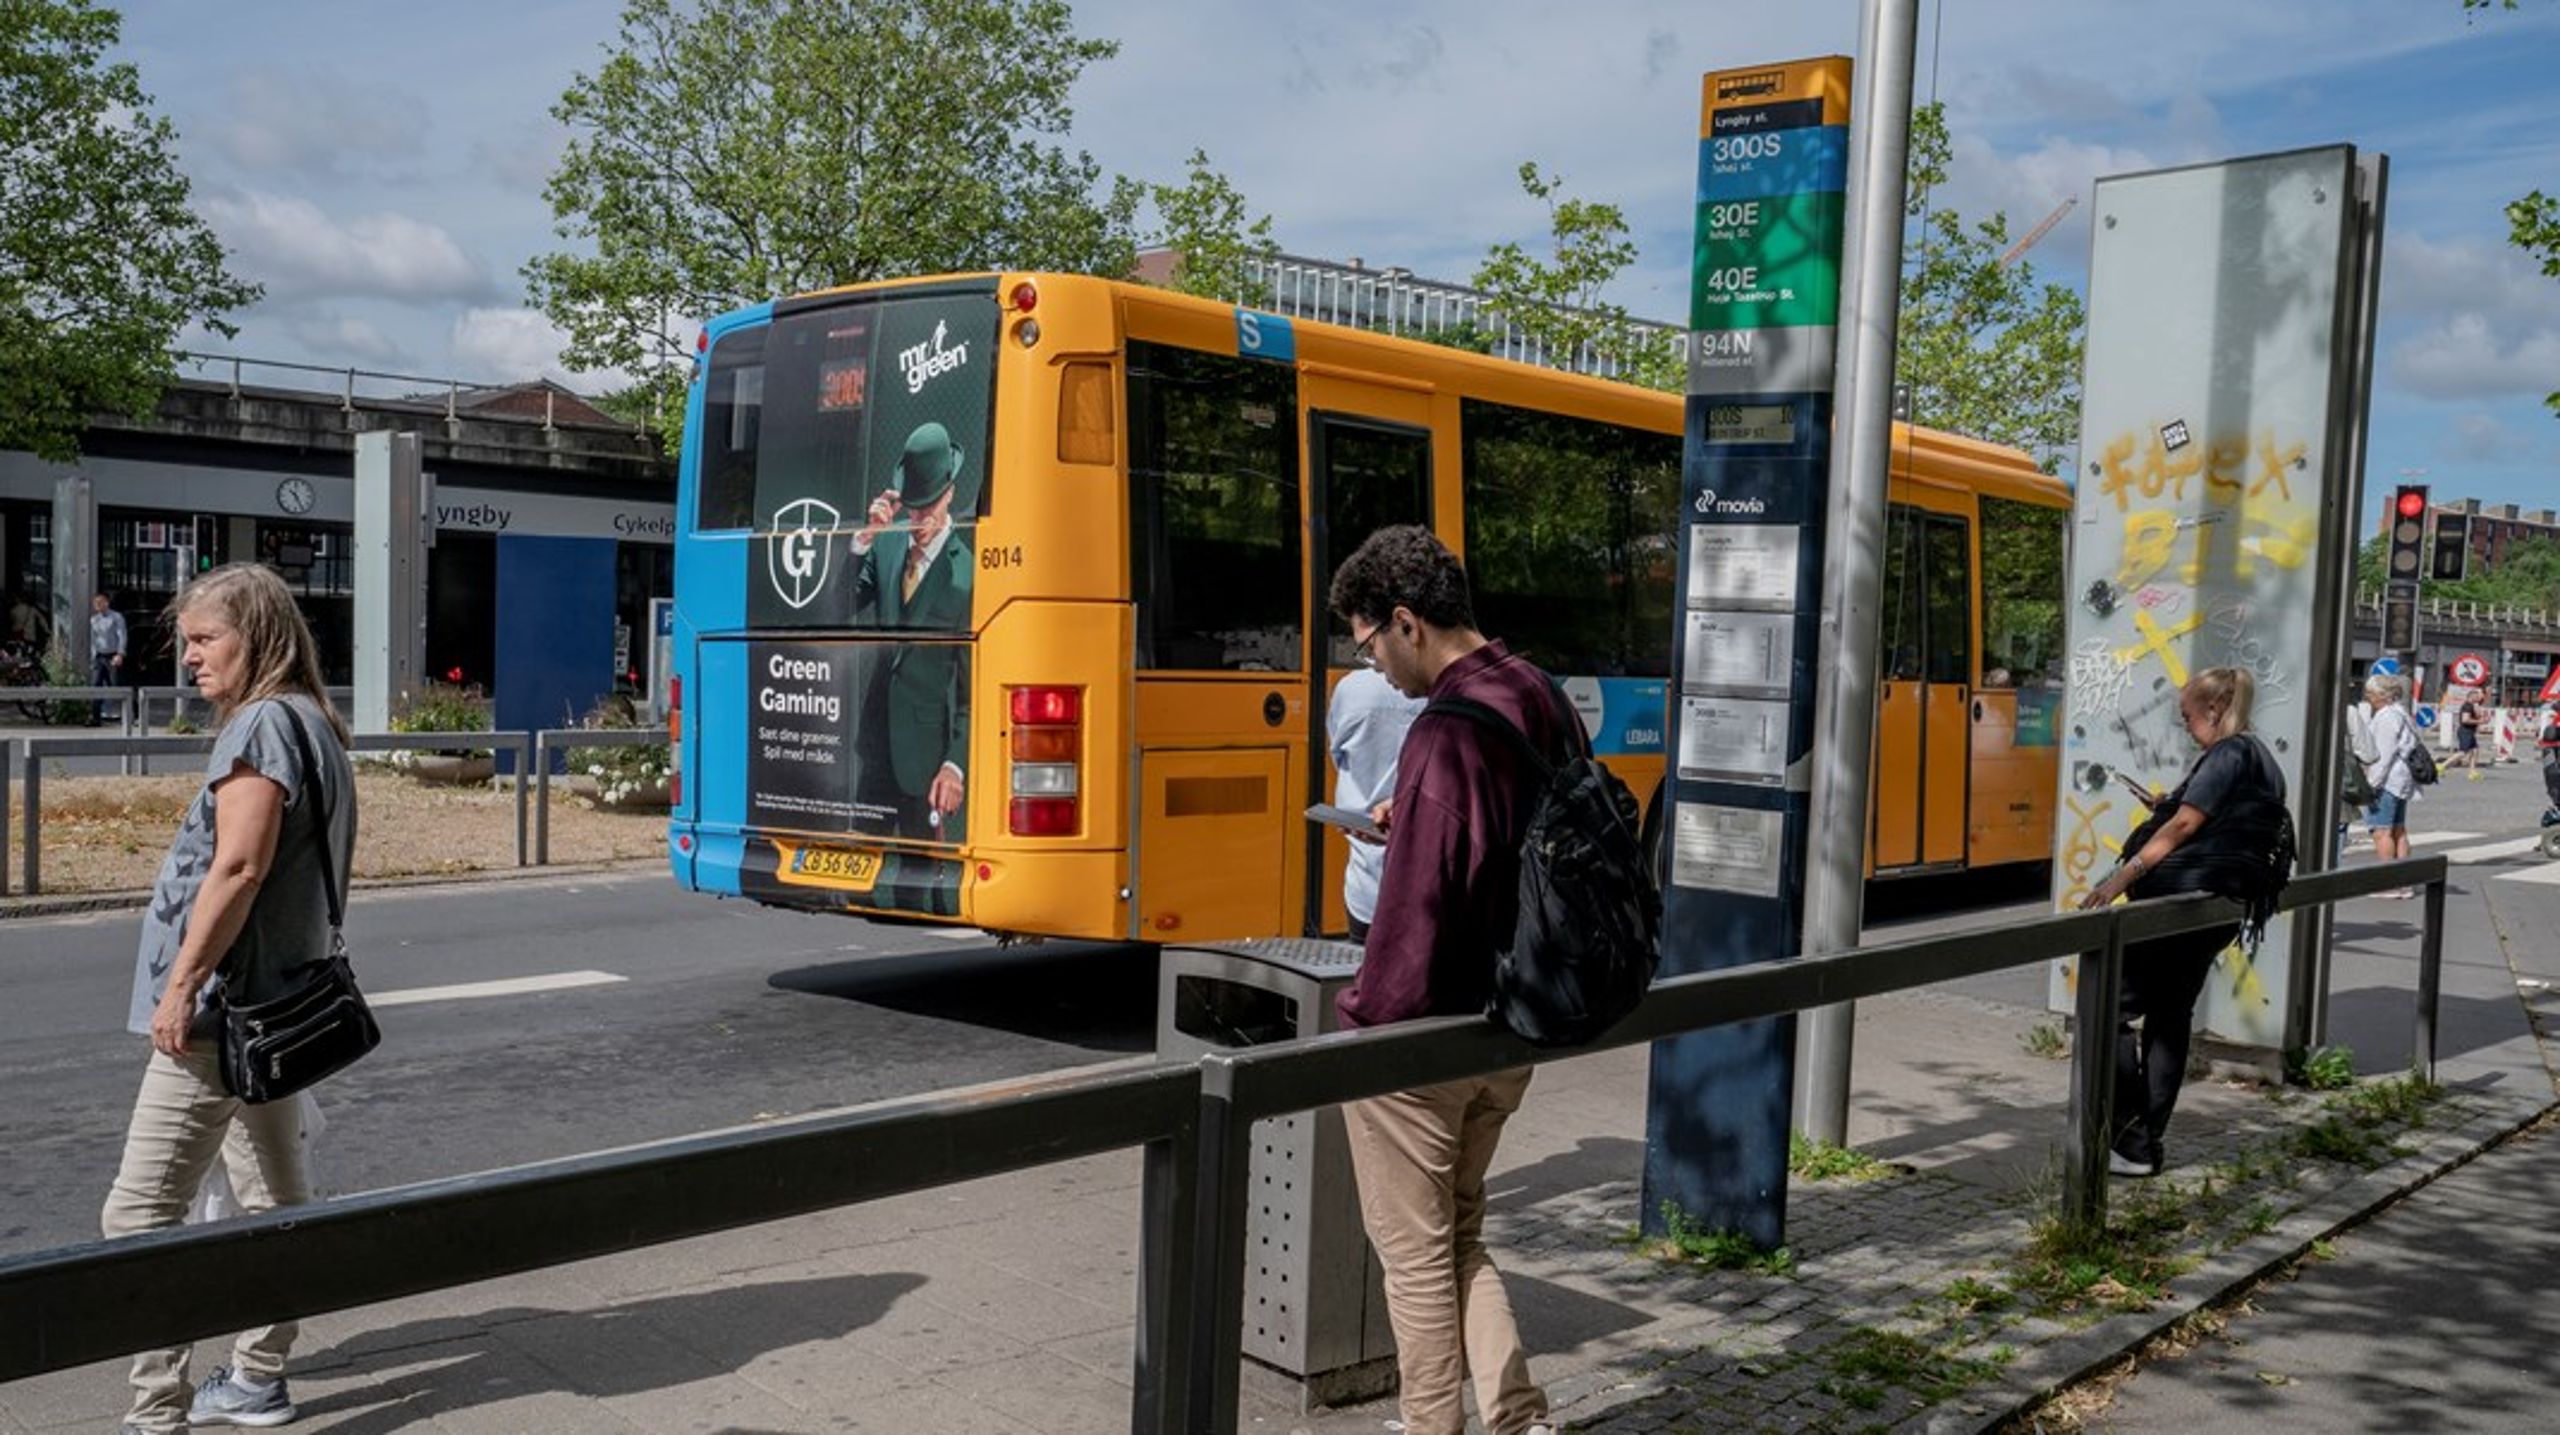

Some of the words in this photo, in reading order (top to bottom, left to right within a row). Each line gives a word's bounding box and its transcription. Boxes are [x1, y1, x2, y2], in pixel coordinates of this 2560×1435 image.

[1714, 133, 1781, 162] 300S
[1710, 202, 1760, 228] 30E
[1707, 267, 1758, 291] 40E
[1241, 313, 1262, 350] S
[1702, 332, 1752, 356] 94N
[906, 343, 968, 395] green
[437, 504, 511, 528] yngby
[1717, 496, 1765, 513] movia
[614, 513, 675, 537] Cykelp
[981, 547, 1022, 570] 6014
[769, 654, 832, 682] Green
[760, 687, 841, 723] Gaming
[780, 728, 800, 742] dine
[1626, 727, 1660, 745] LEBARA
[763, 745, 780, 760] Spil
[782, 748, 805, 761] med
[844, 854, 873, 876] 967
